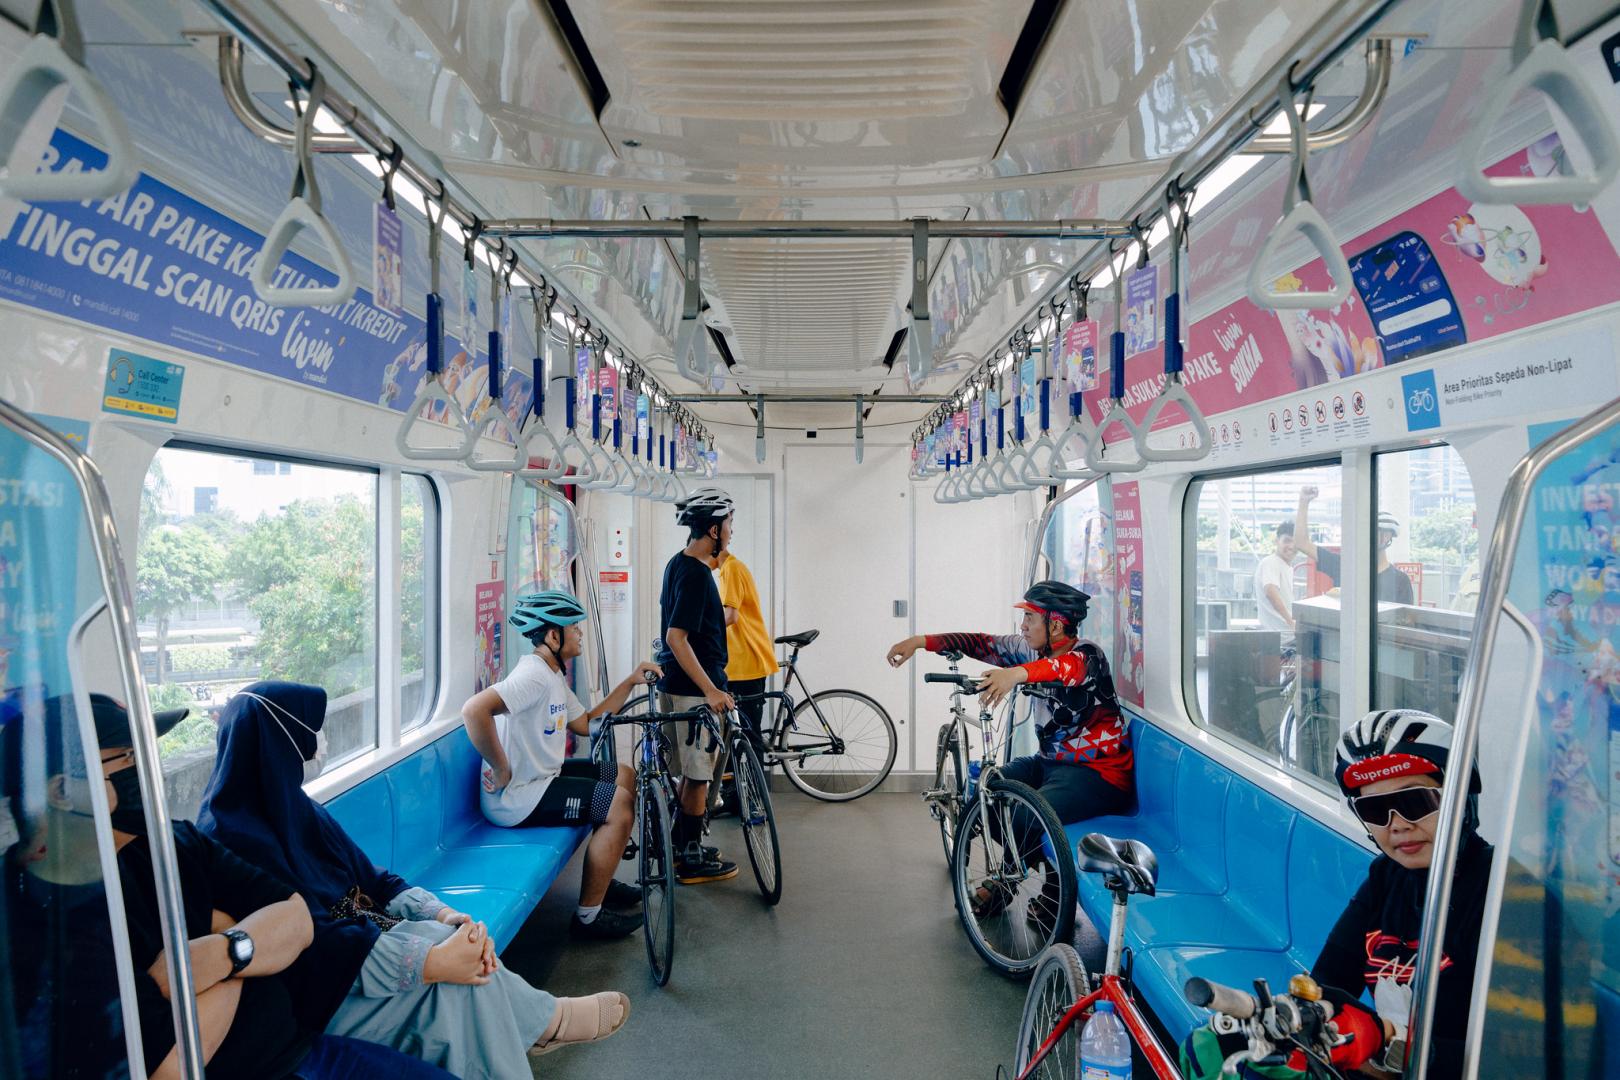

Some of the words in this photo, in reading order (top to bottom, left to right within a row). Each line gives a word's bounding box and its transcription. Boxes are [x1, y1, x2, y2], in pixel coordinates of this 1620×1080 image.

[148, 205, 232, 266] PAKE
[0, 200, 150, 291] TINGGAL
[154, 265, 233, 318] SCAN
[230, 294, 285, 336] QRIS
[1186, 351, 1222, 384] PAKE
[1229, 332, 1264, 394] SUKHA
[1443, 381, 1460, 394] Area
[1461, 374, 1493, 390] Prioritas
[1495, 367, 1525, 384] Sepeda
[1527, 358, 1573, 377] Non-Lipat
[1352, 761, 1411, 781] Supreme
